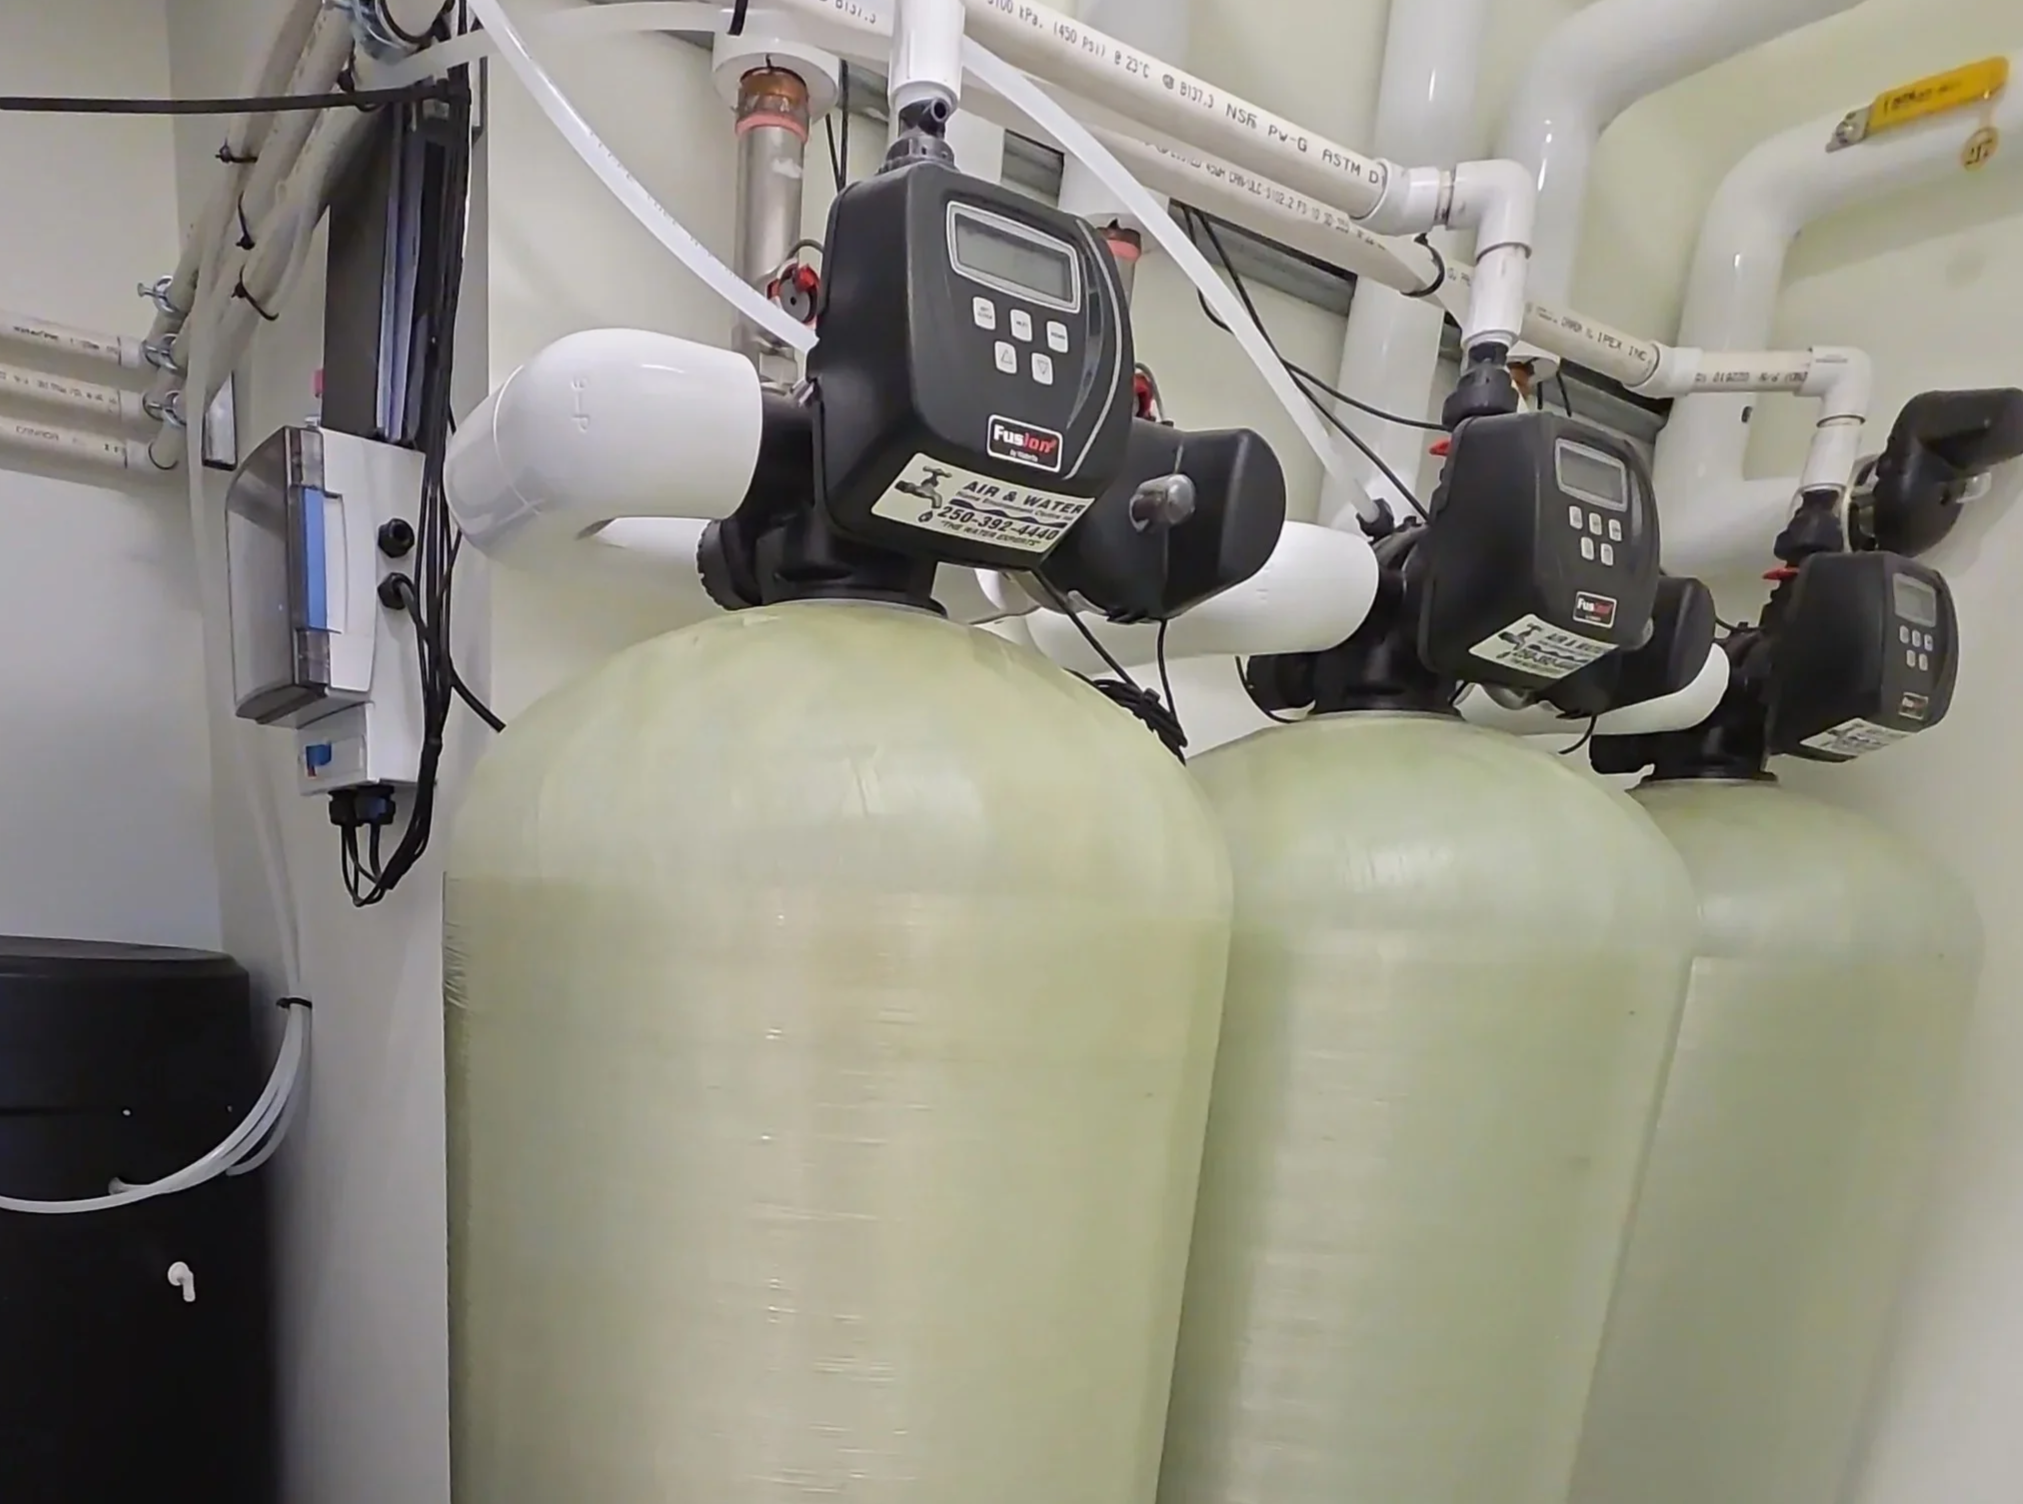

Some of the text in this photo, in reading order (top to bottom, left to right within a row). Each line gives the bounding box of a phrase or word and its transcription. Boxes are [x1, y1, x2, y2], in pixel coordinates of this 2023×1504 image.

[1321, 148, 1361, 177] ASTM
[963, 480, 1086, 515] AIR & WATER
[937, 505, 1062, 541] 250-392-4440
